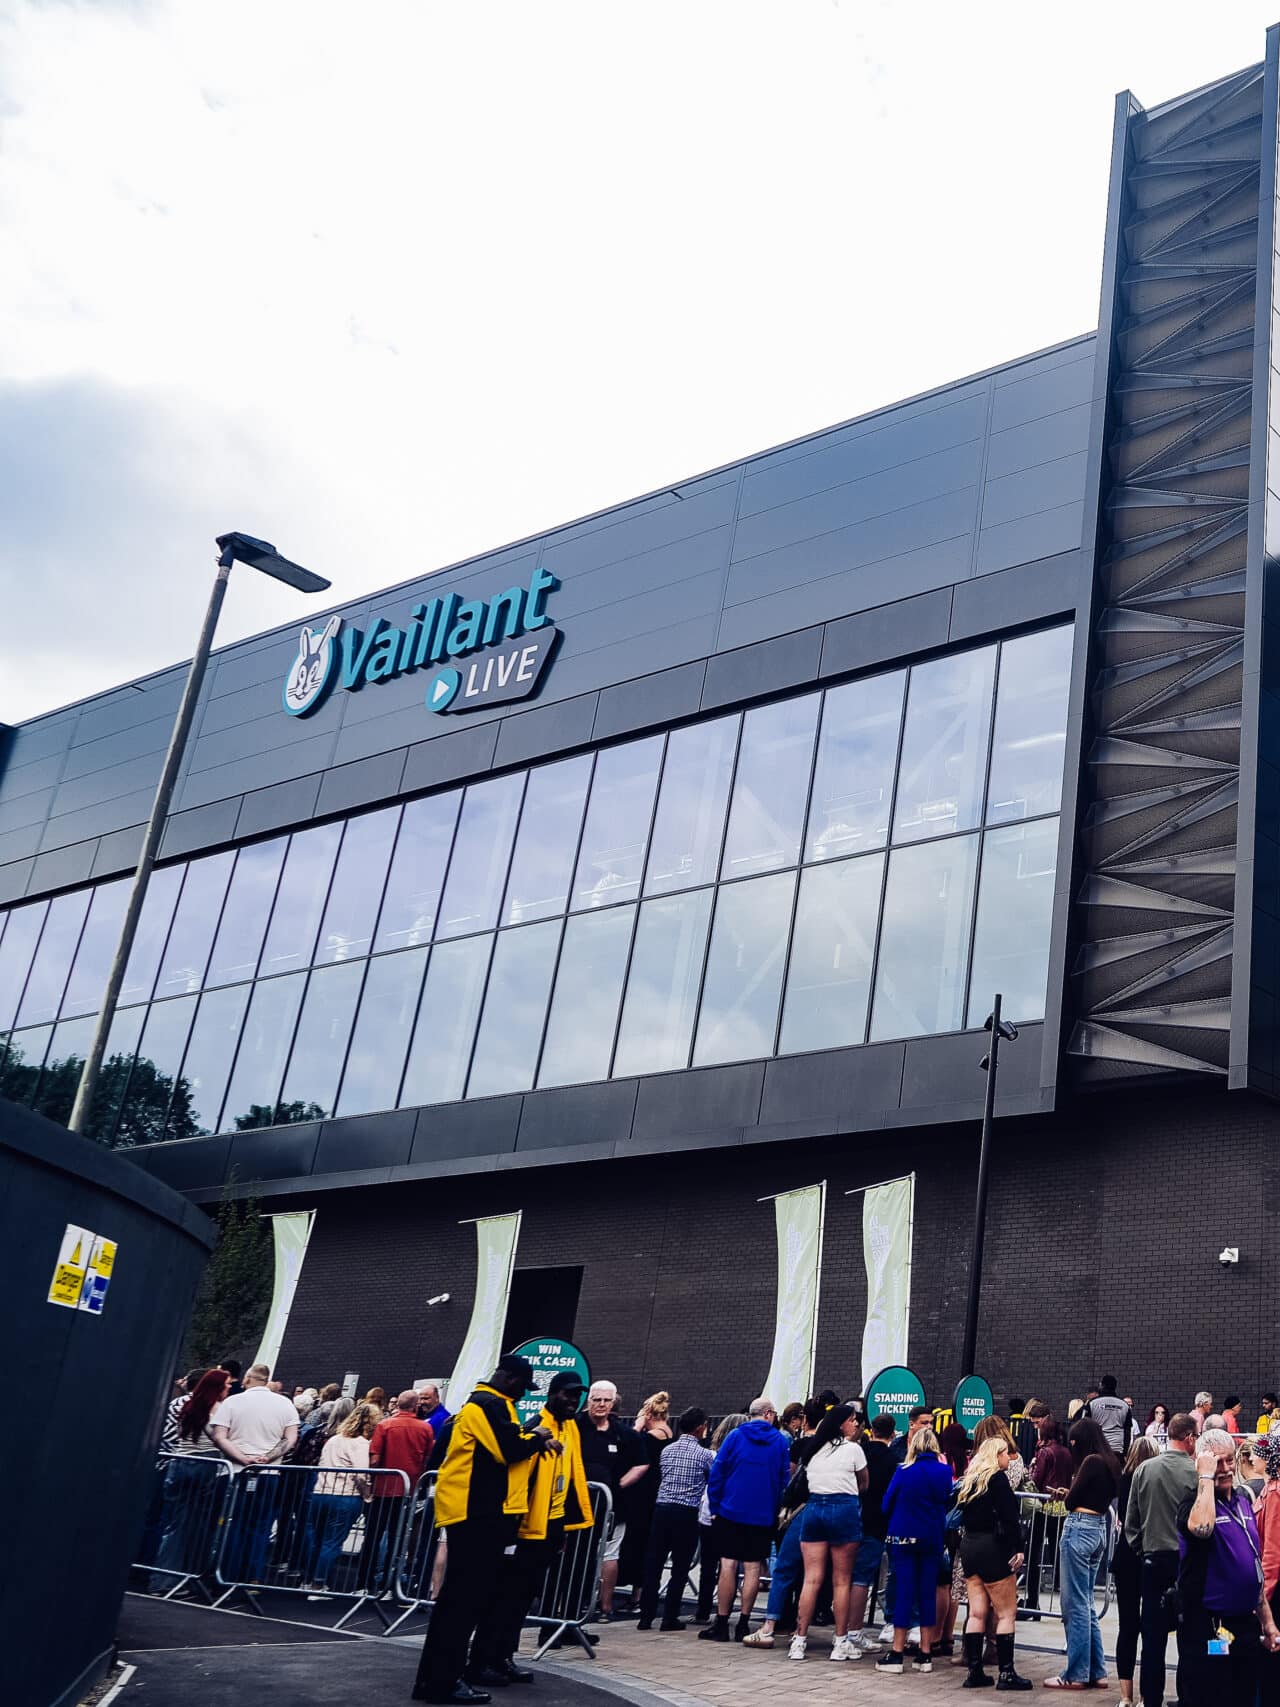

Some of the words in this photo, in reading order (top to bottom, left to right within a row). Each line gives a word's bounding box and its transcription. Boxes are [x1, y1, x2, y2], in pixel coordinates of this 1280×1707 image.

[342, 568, 556, 689] Vaillant
[464, 645, 538, 698] LIVE
[538, 1344, 561, 1354] WIN
[521, 1355, 542, 1366] 1K
[543, 1356, 576, 1367] CASH
[874, 1393, 919, 1403] STANDING
[963, 1397, 985, 1407] SEATED
[962, 1407, 985, 1416] TICKETS
